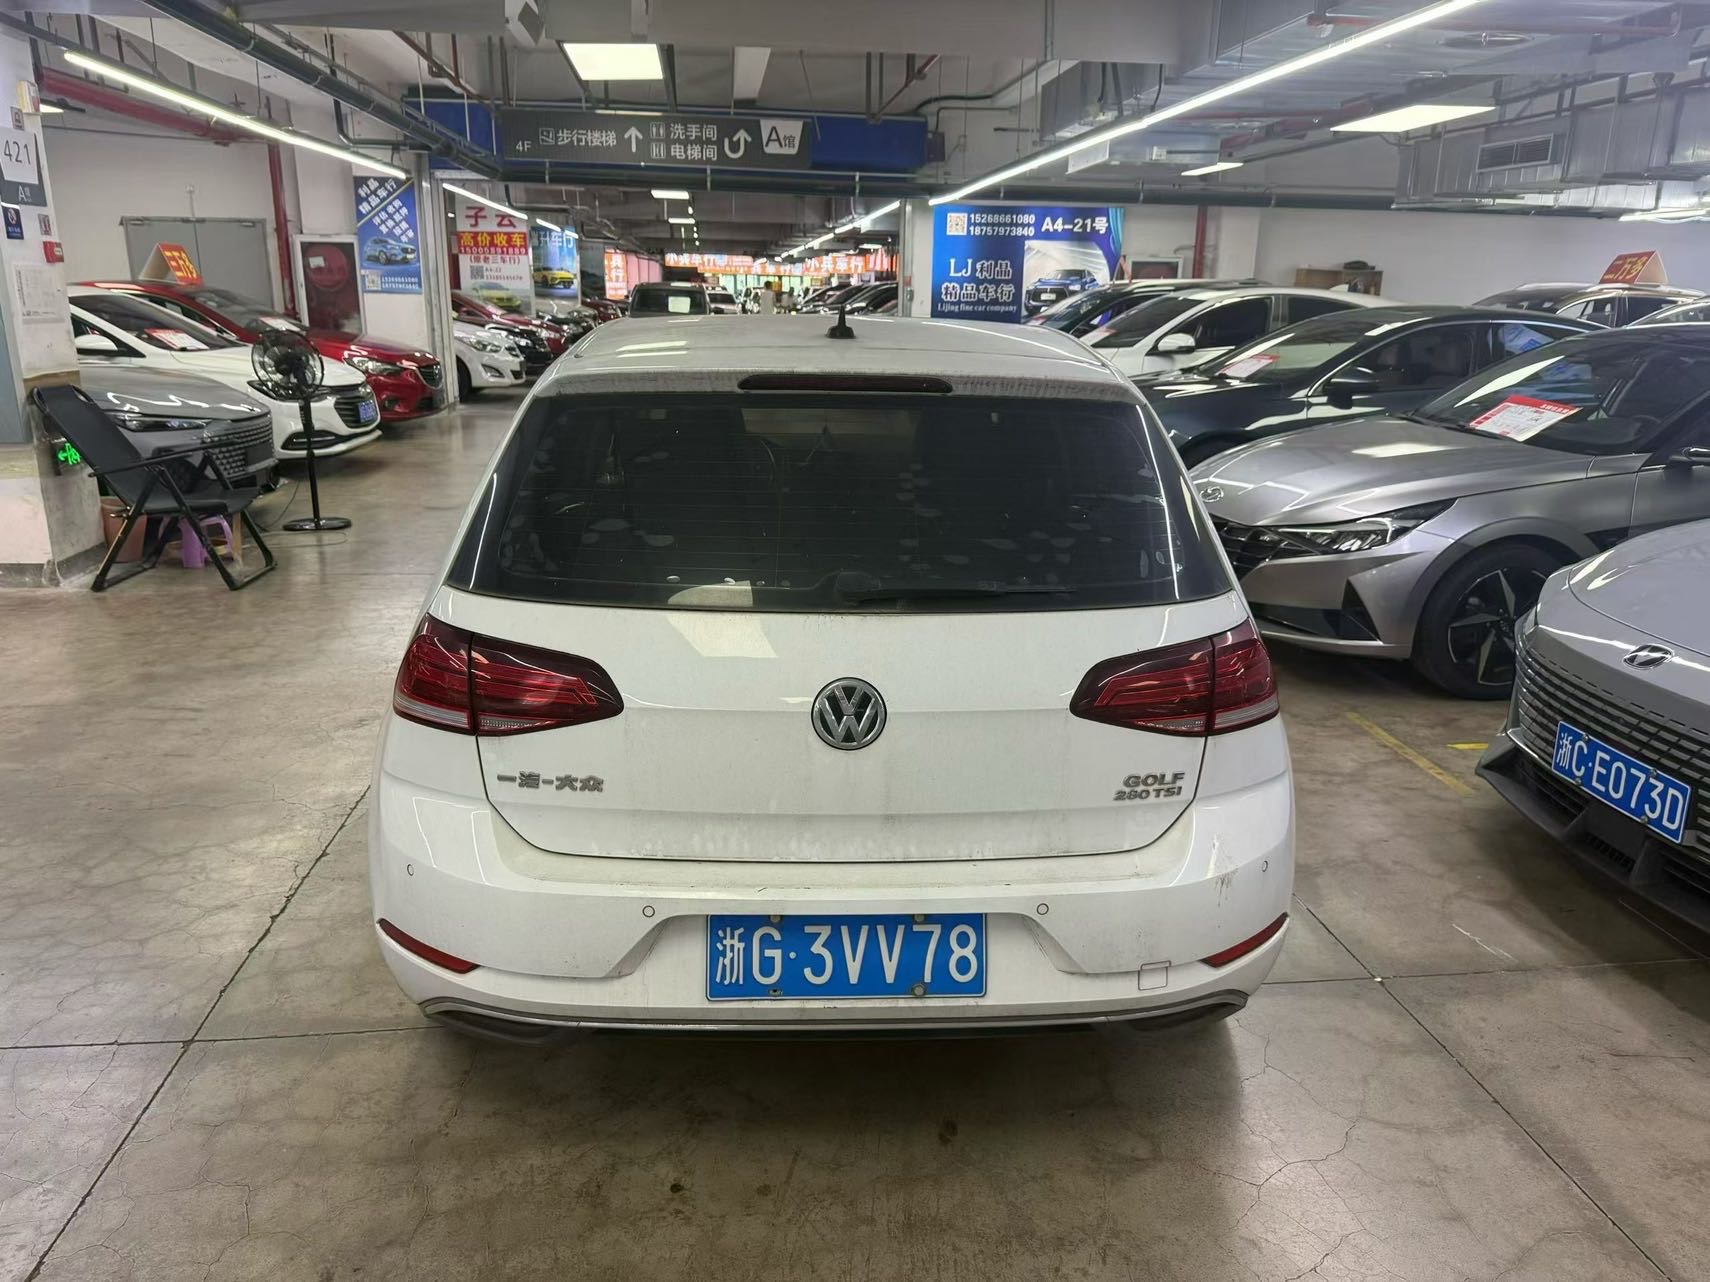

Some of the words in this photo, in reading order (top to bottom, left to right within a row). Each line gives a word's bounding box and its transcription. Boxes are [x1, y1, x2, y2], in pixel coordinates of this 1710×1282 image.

[556, 129, 617, 147] 步行楼梯
[669, 123, 717, 141] 洗手间
[764, 125, 797, 149] A馆
[3, 139, 31, 165] 421
[515, 140, 532, 152] 4F
[670, 143, 717, 161] 电梯间
[969, 213, 1035, 225] 15268661080
[1041, 216, 1108, 234] A4-21号
[460, 232, 525, 247] 高价收车
[969, 225, 1035, 237] 18757973840
[950, 258, 972, 277] LJ
[976, 259, 1012, 279] 利品
[942, 282, 1015, 302] 精品车行
[986, 305, 1017, 314] company
[1123, 772, 1185, 788] GOLF
